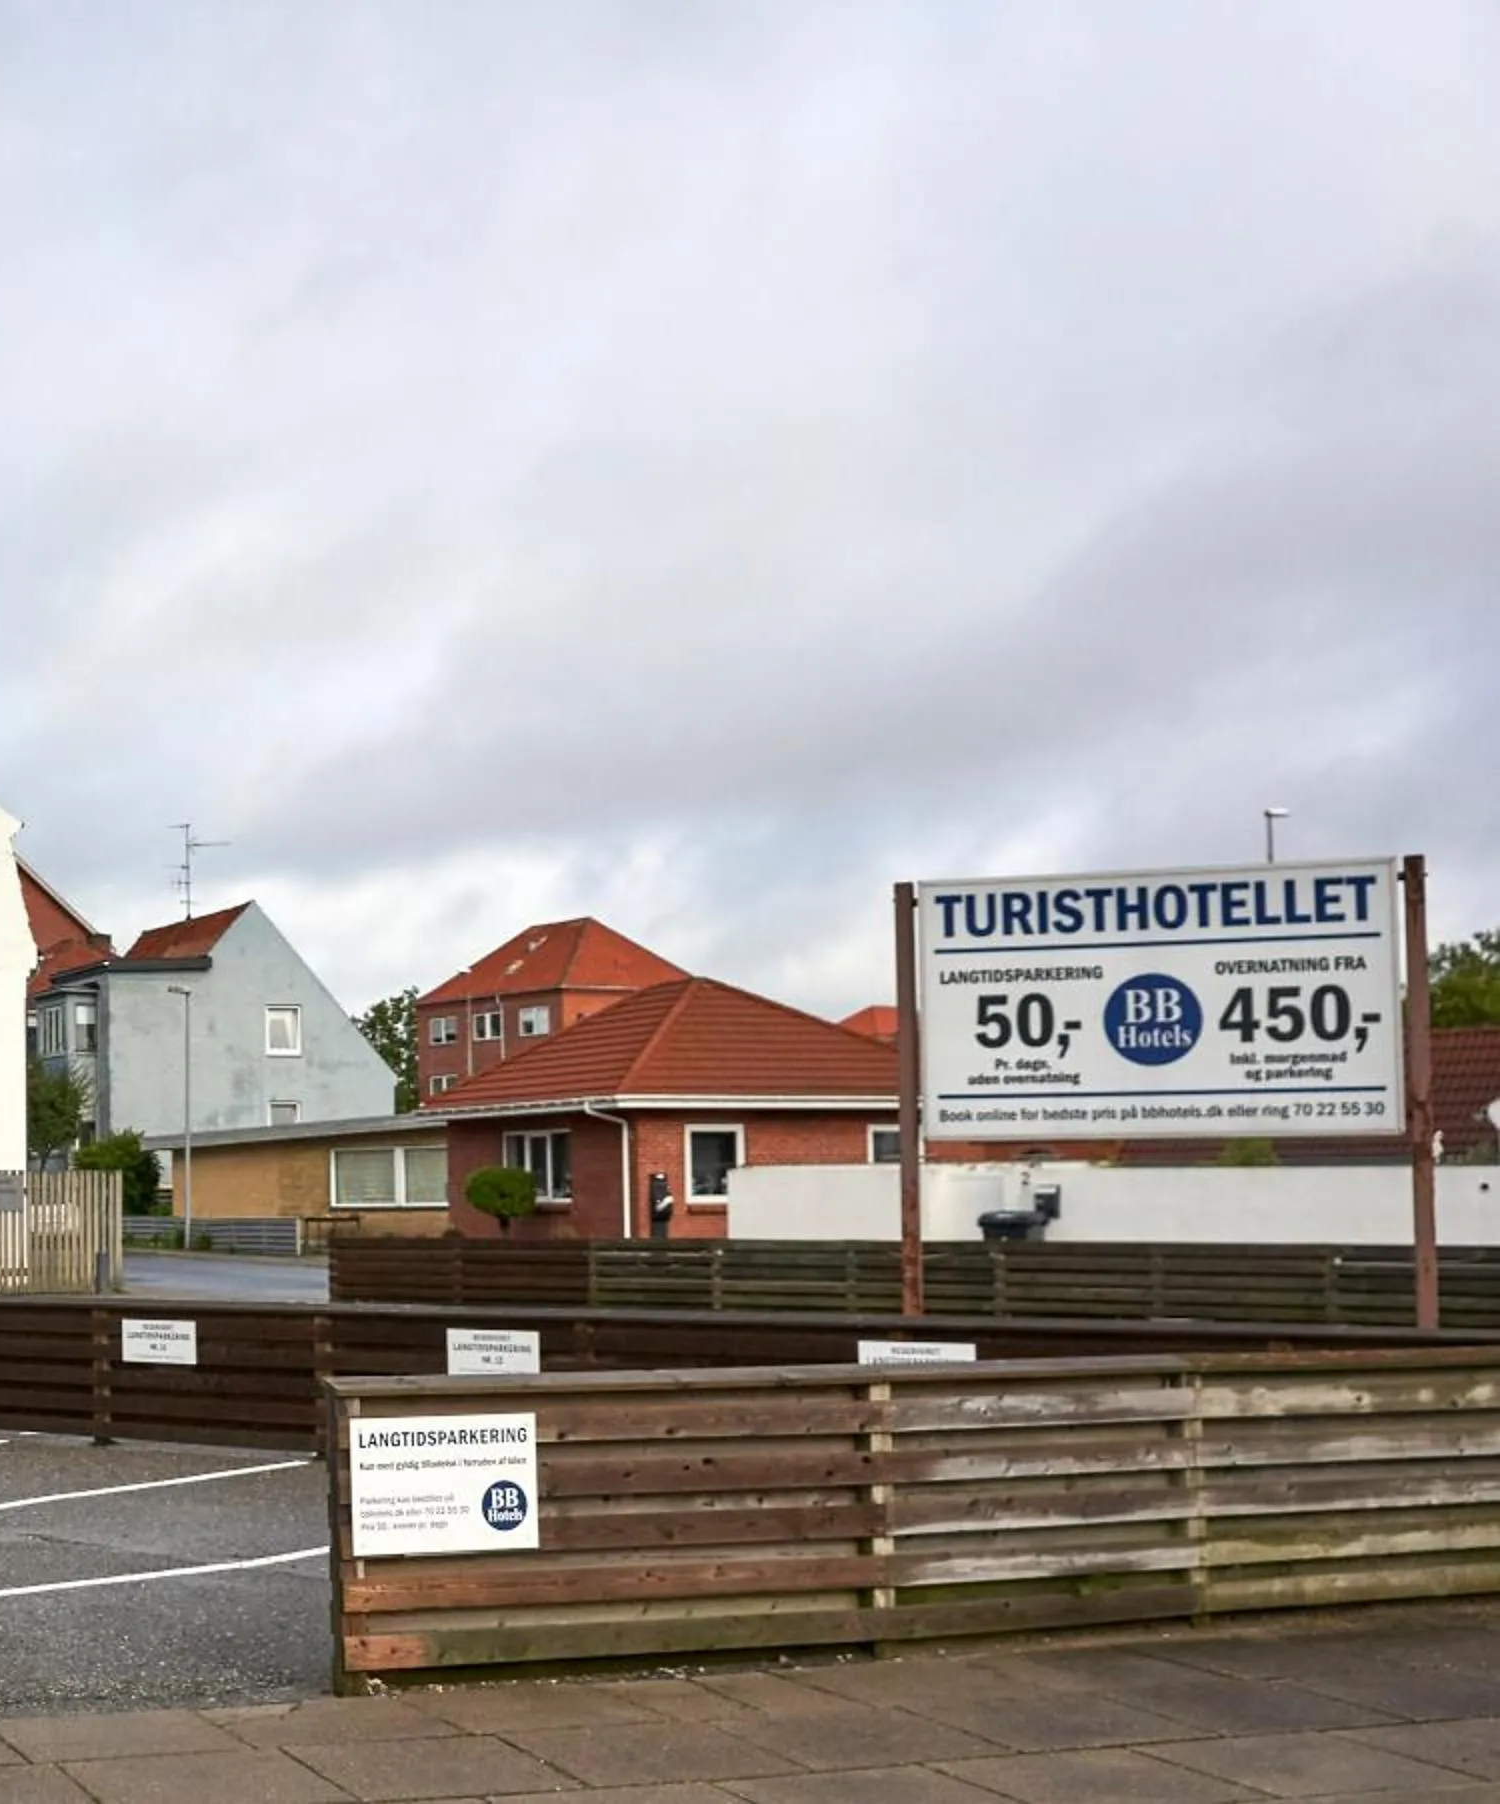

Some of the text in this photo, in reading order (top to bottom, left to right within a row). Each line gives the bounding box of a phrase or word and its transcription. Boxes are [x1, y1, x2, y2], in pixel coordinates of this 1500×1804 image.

[935, 875, 1377, 938] TURISTHOTELLET
[939, 965, 1104, 985] LANGTIDSPARKERING
[1214, 955, 1368, 976] OVERNATNING FRA
[1124, 986, 1184, 1024] BB
[974, 991, 1083, 1059] 50,-
[1218, 983, 1382, 1054] 450,-
[1116, 1024, 1194, 1051] Hotels
[1002, 1072, 1082, 1086] overnatning
[1264, 1065, 1334, 1081] parkering
[938, 1108, 973, 1123] Book
[975, 1108, 1018, 1122] online
[1020, 1107, 1039, 1121] for
[1041, 1107, 1088, 1121] bedste
[1091, 1107, 1117, 1124] pris
[1119, 1104, 1139, 1123] på
[1226, 1103, 1259, 1118] eller
[1261, 1104, 1290, 1120] ring
[1292, 1102, 1313, 1117] 70
[1315, 1101, 1336, 1116] 22
[1340, 1101, 1361, 1116] 55
[1364, 1100, 1385, 1116] 30
[358, 1427, 528, 1449] LANGTIDSPARKERING
[490, 1487, 519, 1509] BB
[487, 1508, 524, 1523] Hotels
